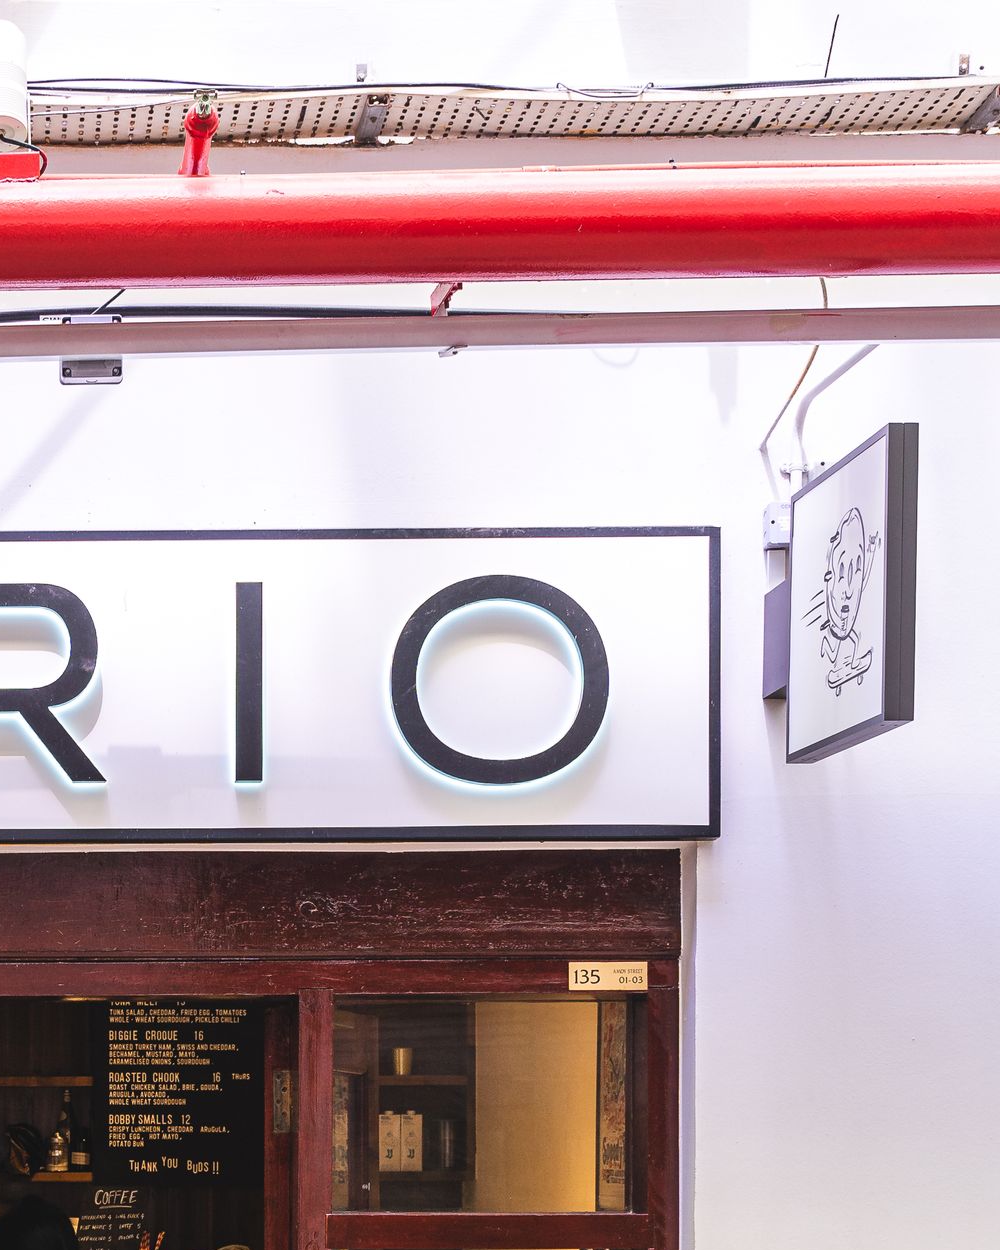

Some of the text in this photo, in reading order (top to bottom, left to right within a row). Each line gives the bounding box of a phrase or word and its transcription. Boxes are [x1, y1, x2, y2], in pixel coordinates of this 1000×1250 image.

[574, 969, 600, 984] 135
[109, 1031, 138, 1040] BIGGIE
[194, 1031, 204, 1040] 16
[109, 1072, 146, 1082] ROASTED
[153, 1072, 180, 1082] CHOOK
[213, 1072, 220, 1082] 16
[109, 1115, 190, 1124] BOBBY SMALLS 12
[129, 1160, 157, 1172] THANK
[162, 1156, 178, 1168] YOU
[94, 1190, 138, 1205] COFFEE
